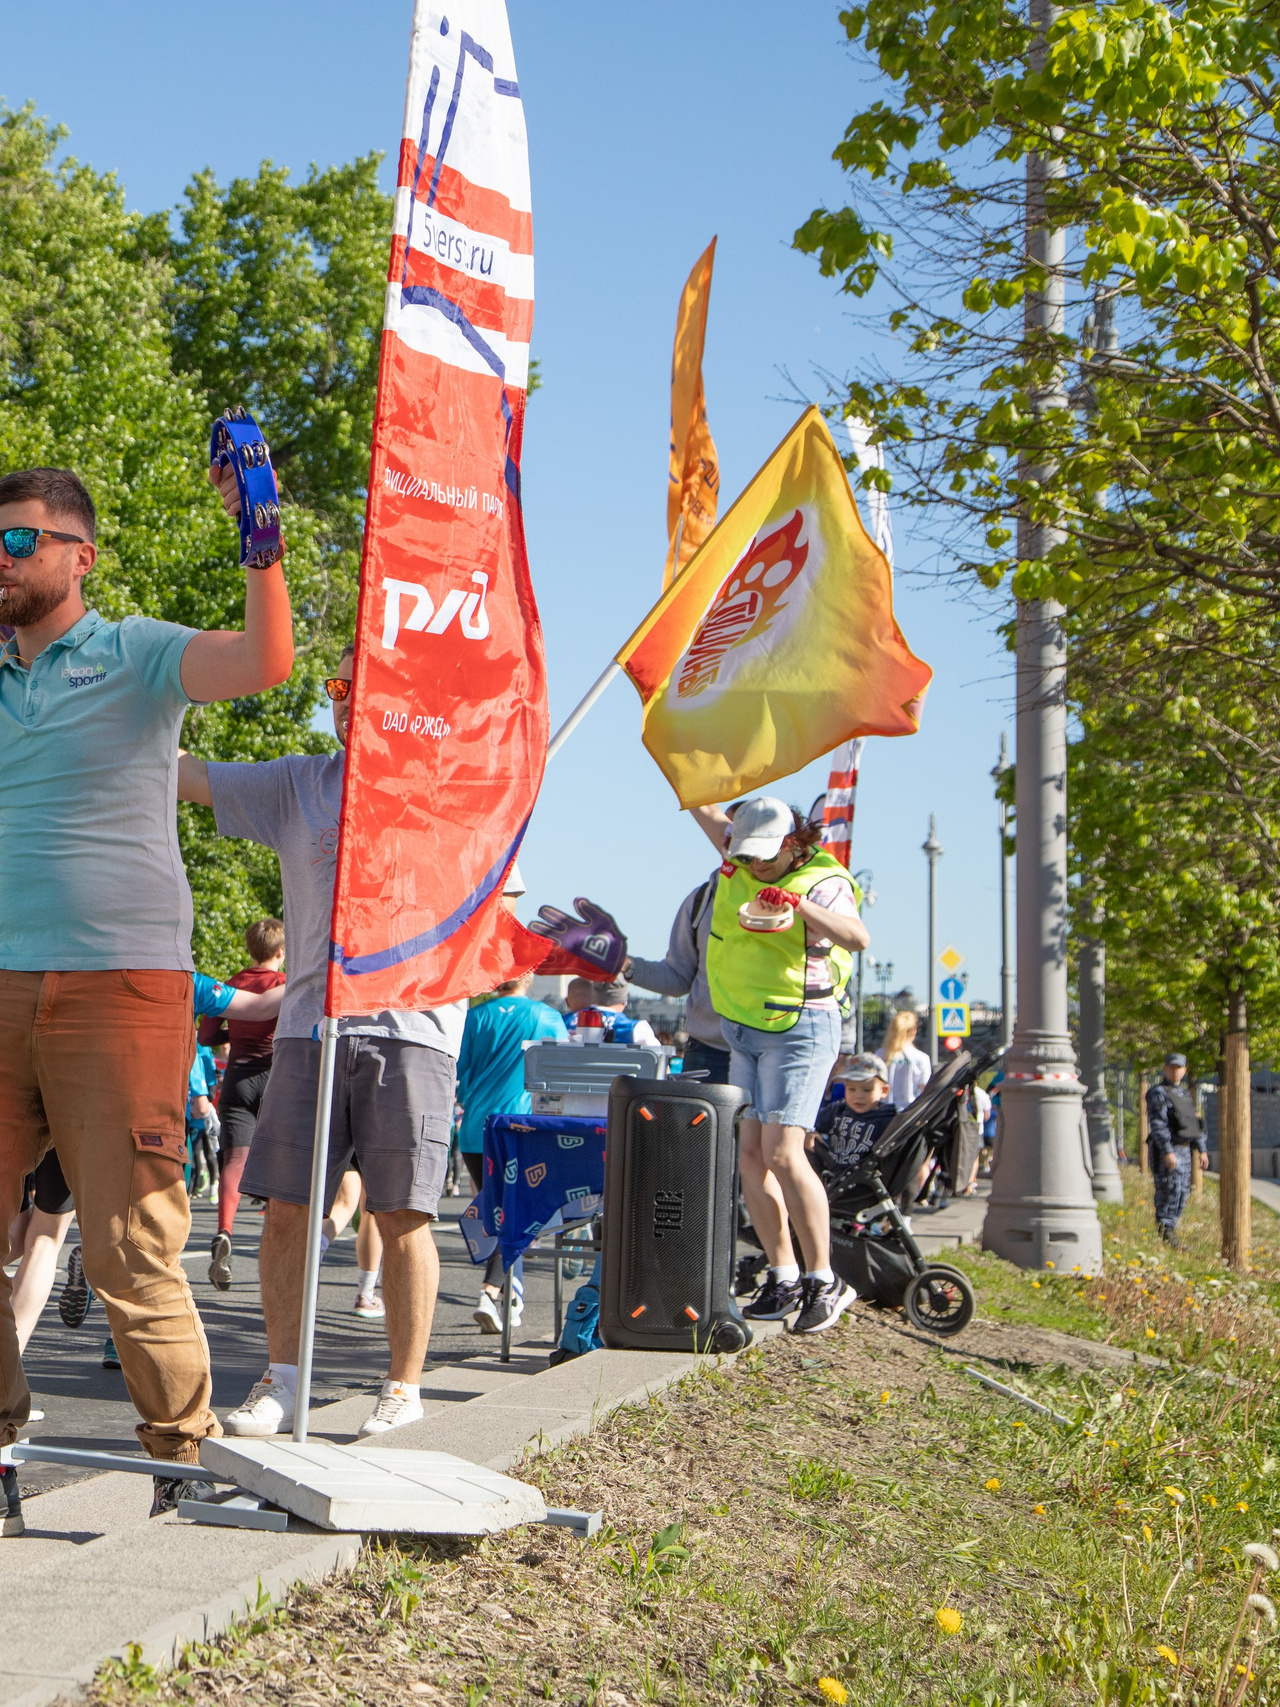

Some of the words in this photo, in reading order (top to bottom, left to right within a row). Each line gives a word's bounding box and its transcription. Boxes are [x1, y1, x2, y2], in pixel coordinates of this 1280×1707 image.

[69, 671, 108, 688] sportif
[382, 710, 408, 733] ОАО
[653, 1189, 684, 1238] JBL
